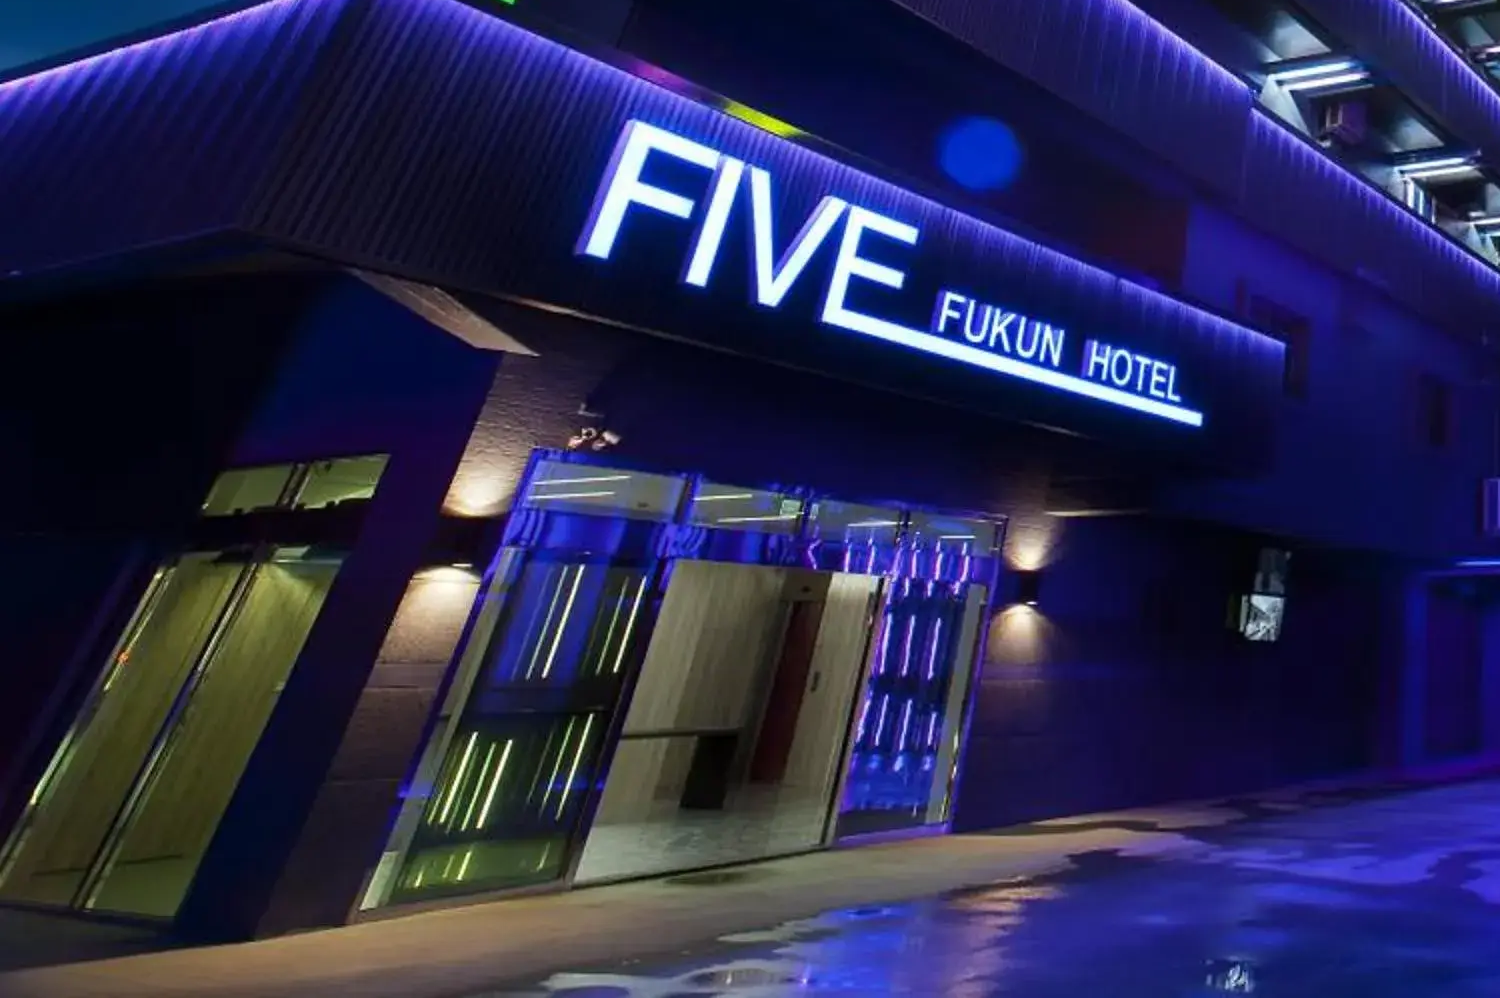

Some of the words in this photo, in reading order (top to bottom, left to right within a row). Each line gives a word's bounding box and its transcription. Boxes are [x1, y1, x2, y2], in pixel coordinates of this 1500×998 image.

[582, 118, 919, 326] FIVE
[936, 291, 1065, 367] FUKUN
[1086, 340, 1181, 403] HOTEL
